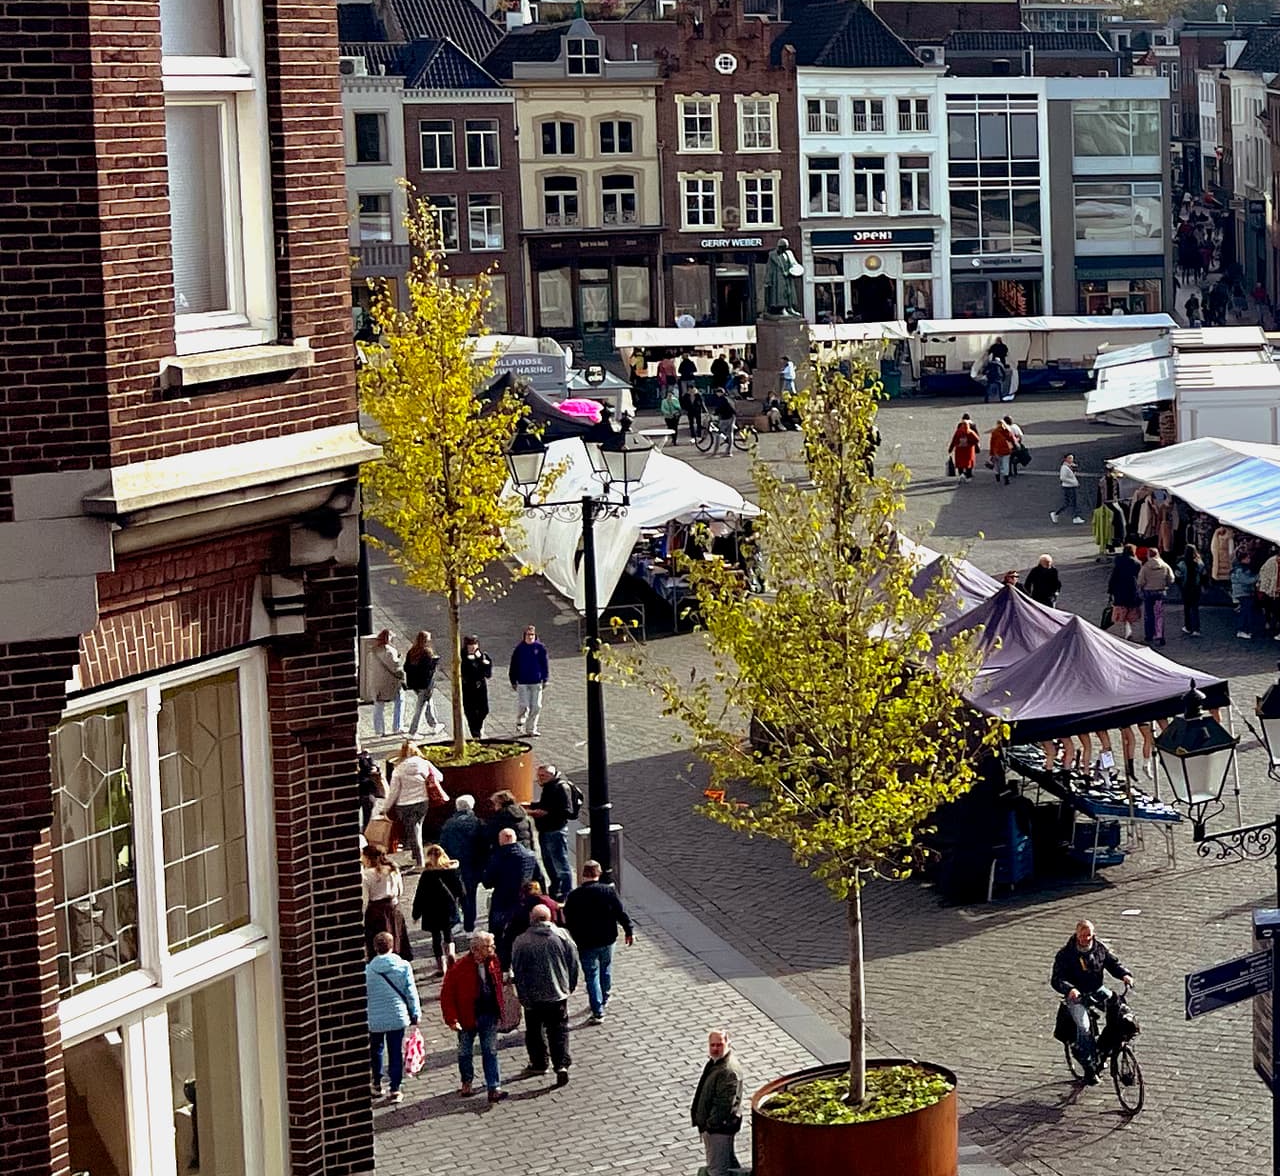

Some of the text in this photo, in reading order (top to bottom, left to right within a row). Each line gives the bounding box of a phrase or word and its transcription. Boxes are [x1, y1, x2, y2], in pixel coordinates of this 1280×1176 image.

[701, 237, 762, 247] GERRY WEBER
[516, 365, 553, 375] HARING
